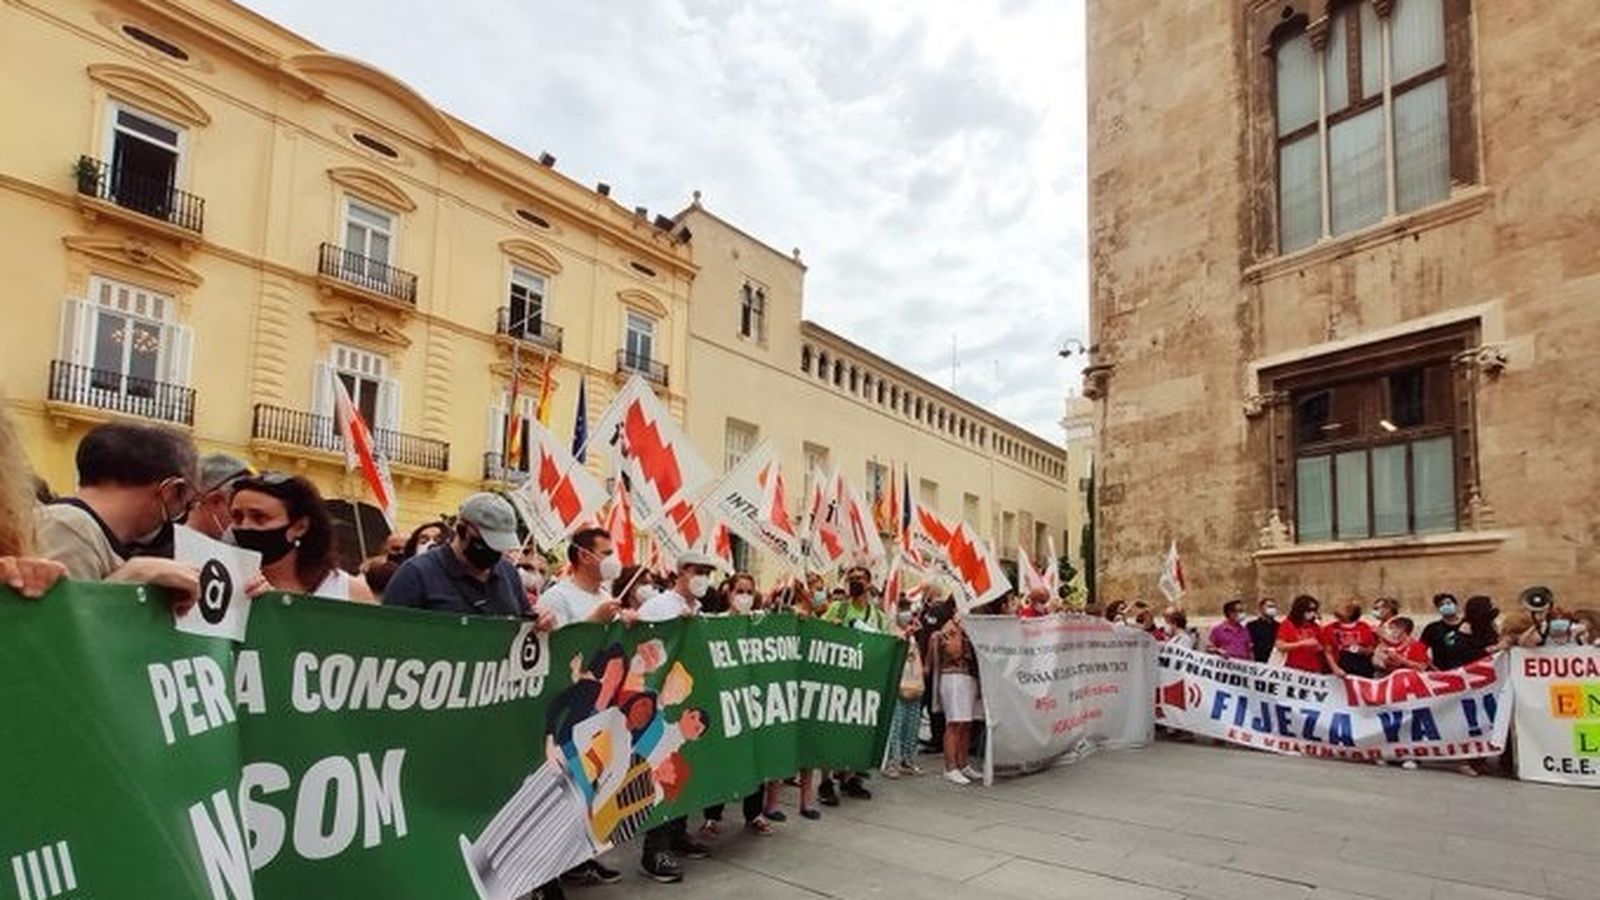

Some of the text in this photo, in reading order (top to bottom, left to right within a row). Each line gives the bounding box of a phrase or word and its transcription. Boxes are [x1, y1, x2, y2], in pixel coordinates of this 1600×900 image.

[807, 641, 864, 671] INTERÍ
[1524, 658, 1600, 677] EDUCA
[148, 656, 237, 745] PER
[800, 681, 881, 727] TIRAR
[1254, 679, 1281, 696] DE
[1286, 686, 1330, 703] LEY
[1211, 690, 1356, 748] FIJEZA
[1377, 707, 1441, 743] YA
[1542, 755, 1597, 775] C.E.E.
